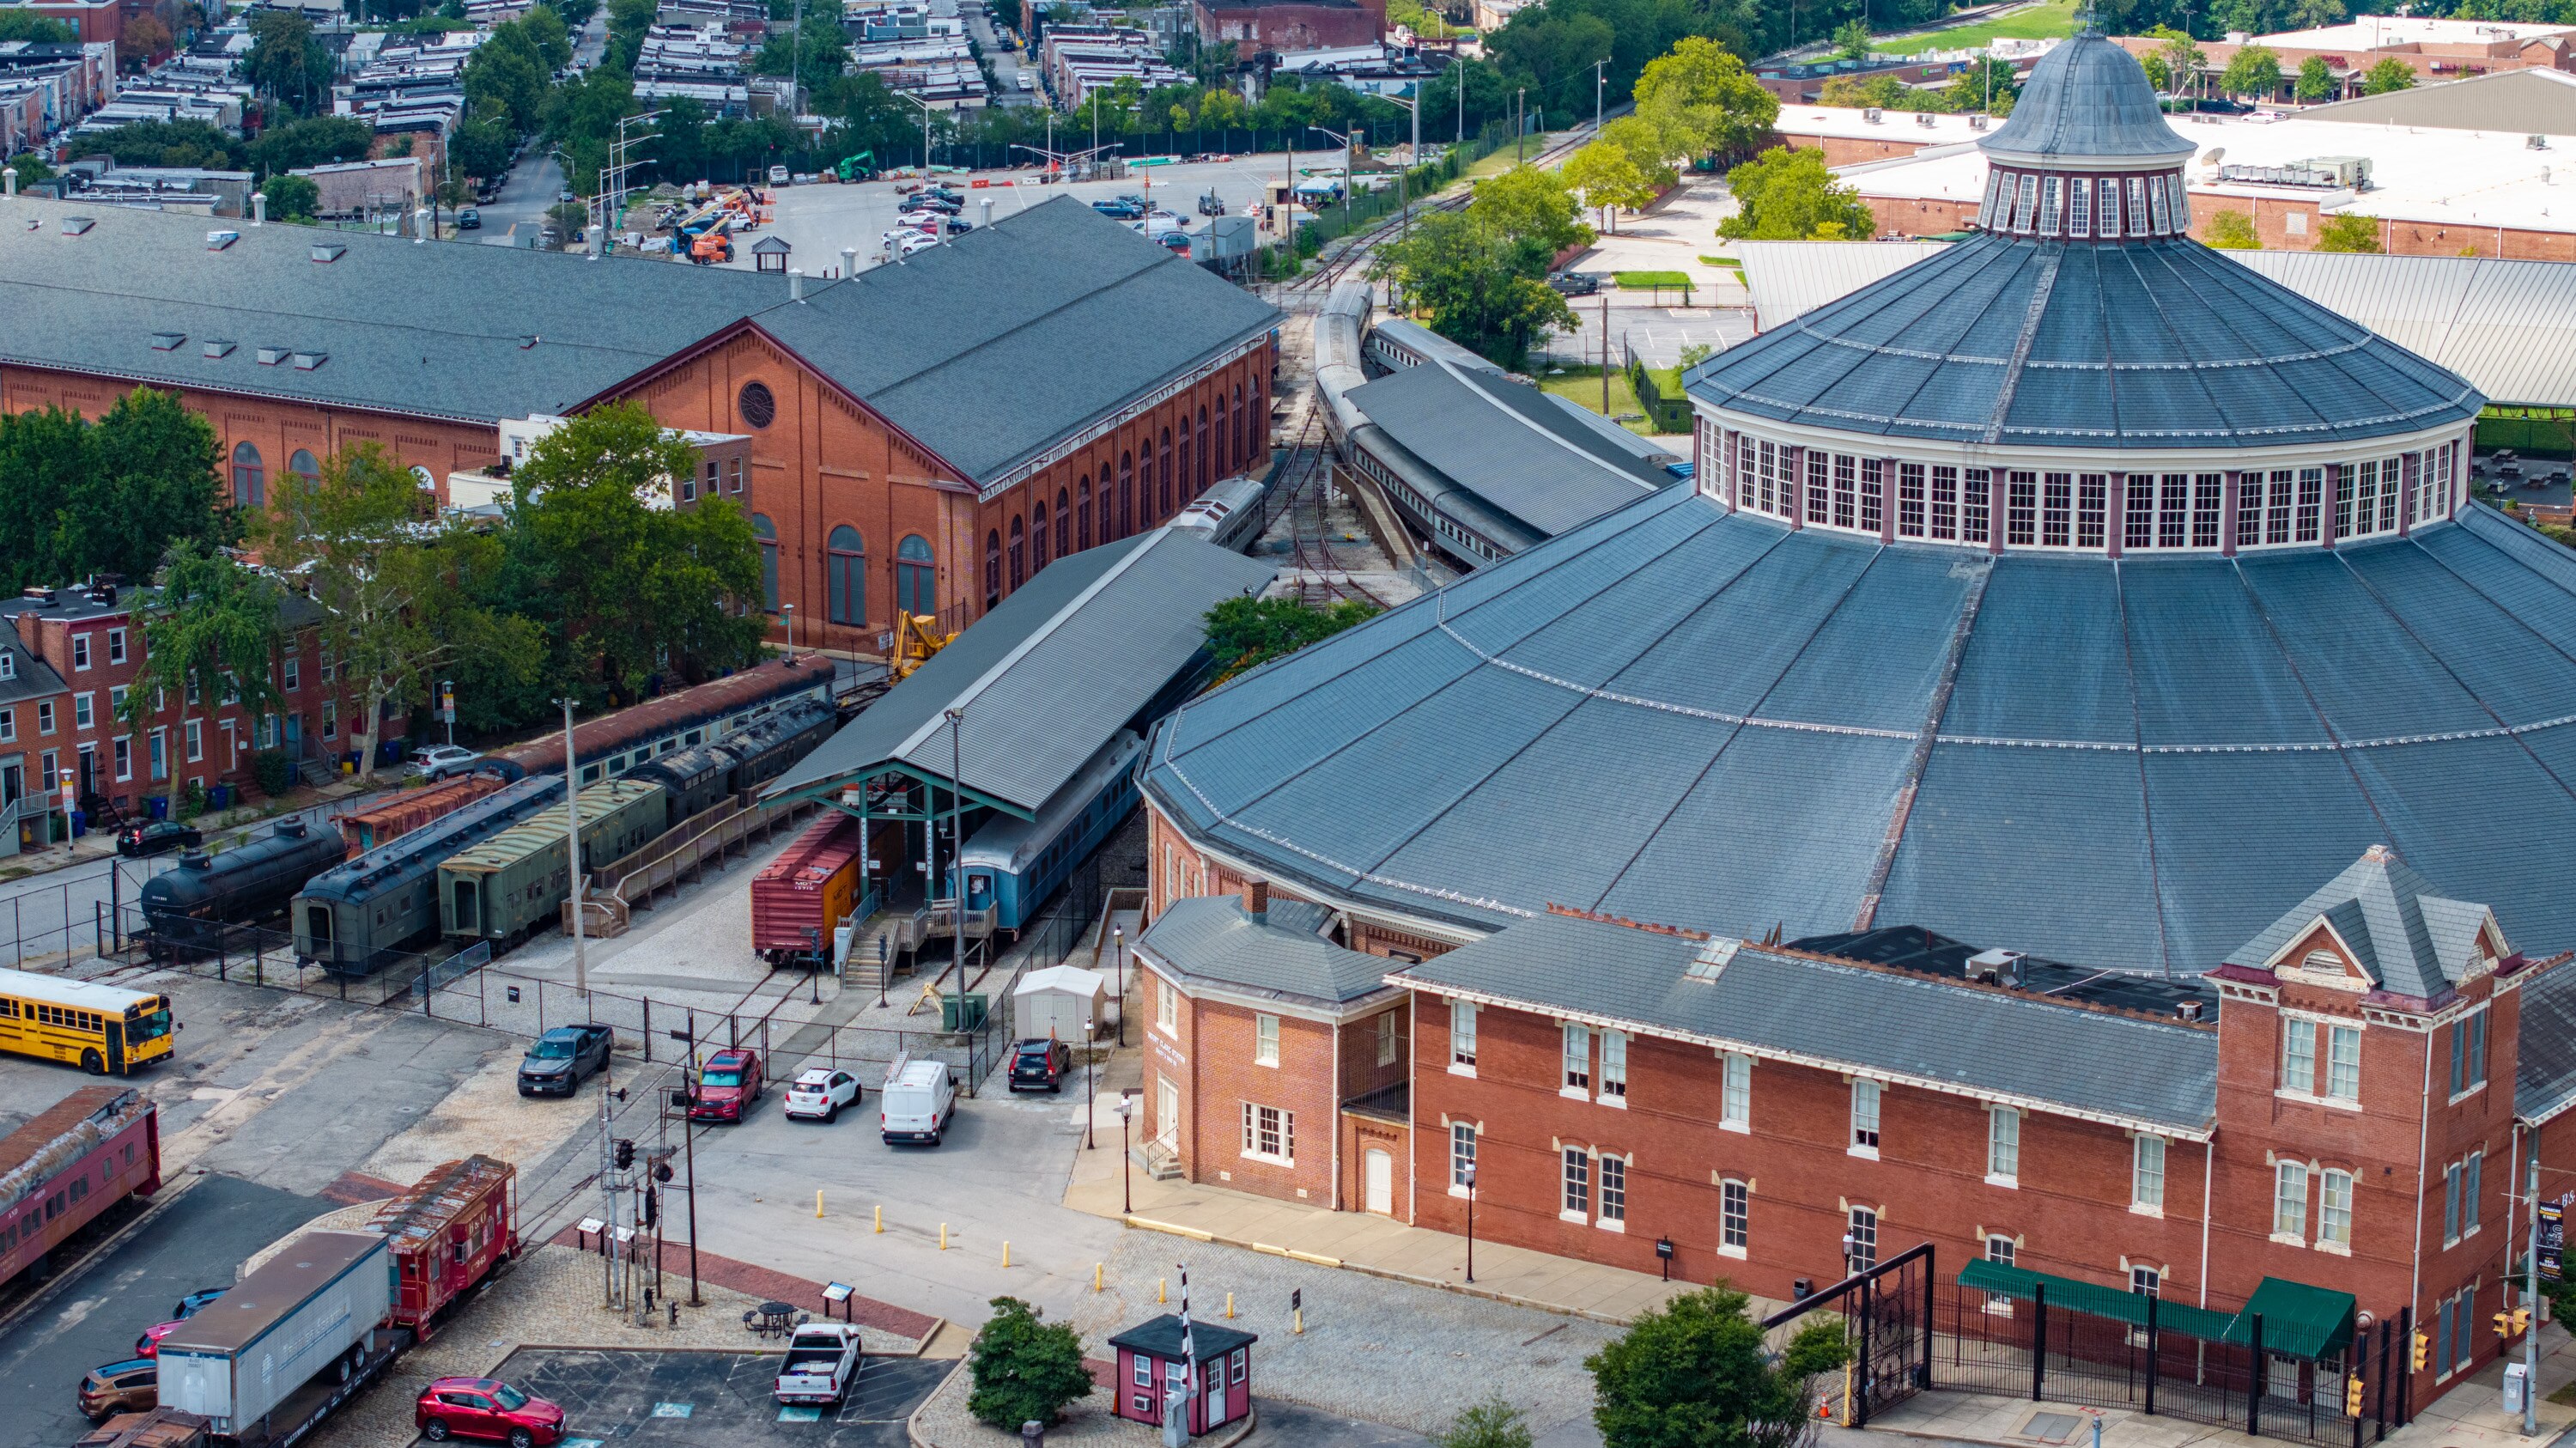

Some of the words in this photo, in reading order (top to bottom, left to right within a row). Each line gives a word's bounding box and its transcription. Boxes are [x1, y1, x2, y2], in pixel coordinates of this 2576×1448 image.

[981, 465, 1030, 502] BALTIMORE
[1052, 442, 1072, 461] OHIO
[1079, 429, 1099, 446] RAIL
[1108, 410, 1129, 429] ROAD
[1182, 360, 1221, 387] PASSENGER
[1226, 349, 1239, 363] CAR
[34, 1189, 46, 1201] OHIO
[9, 1208, 18, 1220] AND
[284, 1421, 310, 1448] BALTIMORE
[315, 1407, 326, 1422] OHIO
